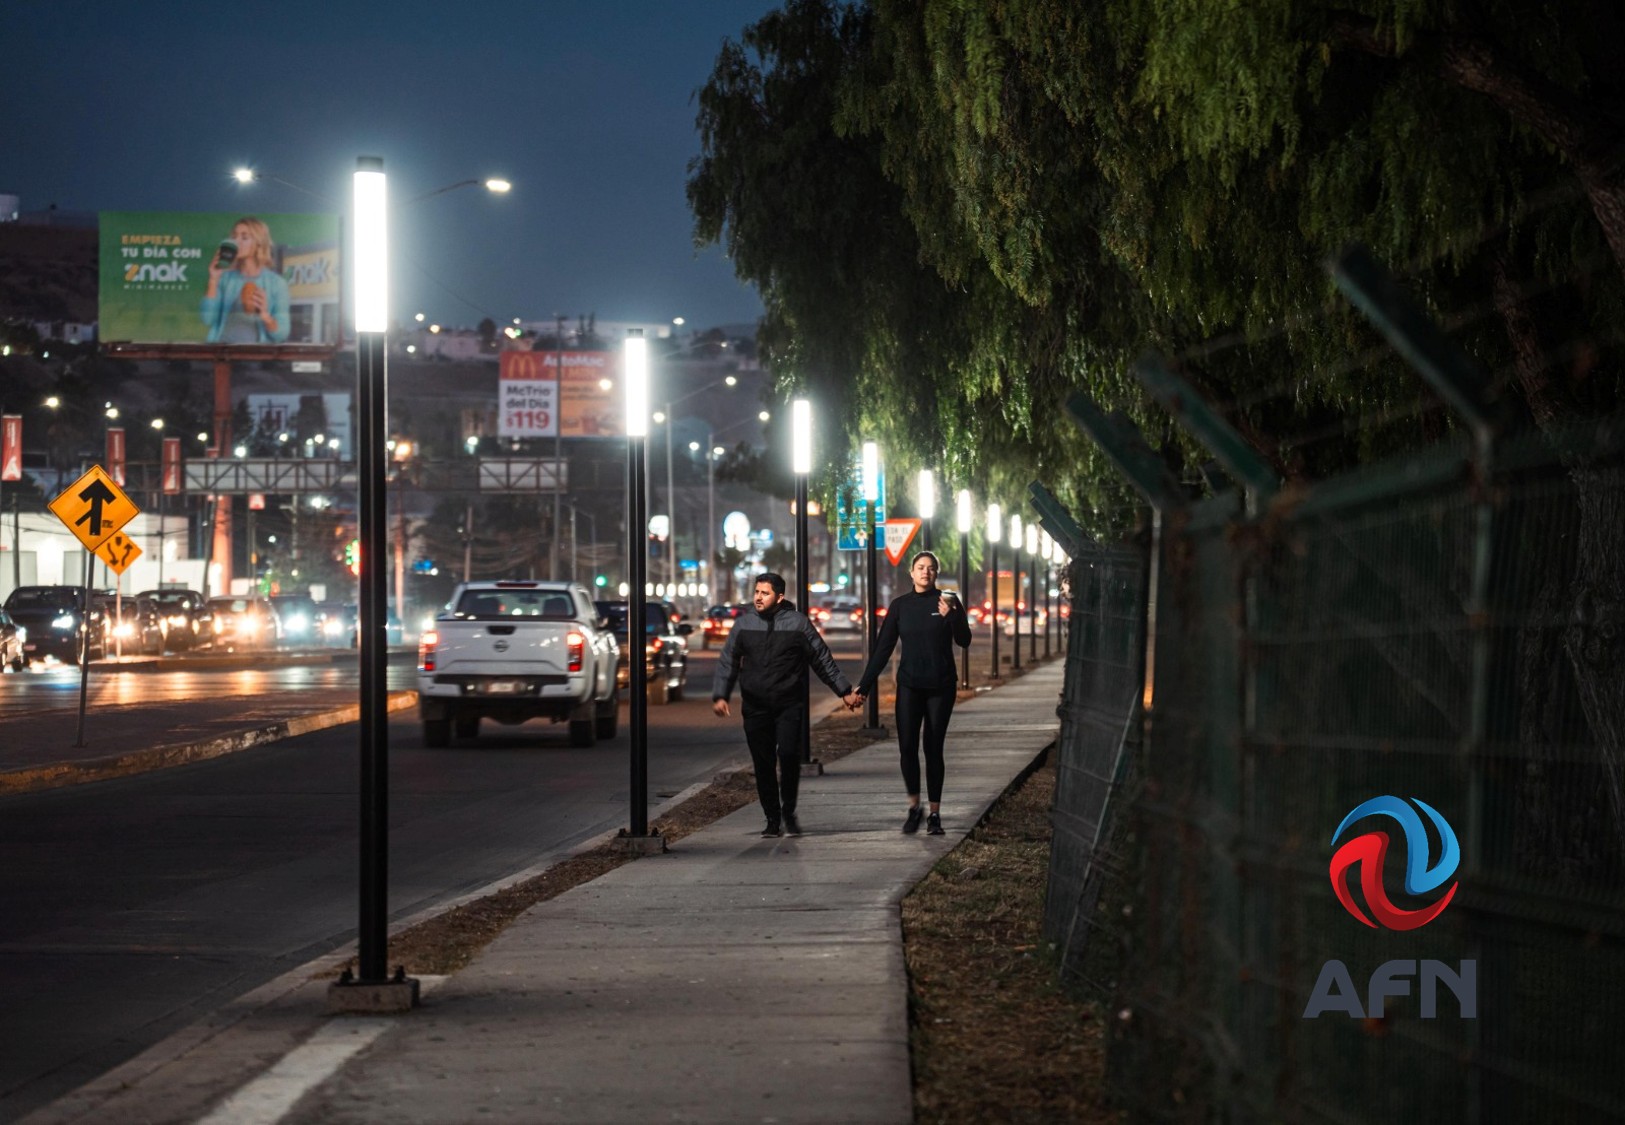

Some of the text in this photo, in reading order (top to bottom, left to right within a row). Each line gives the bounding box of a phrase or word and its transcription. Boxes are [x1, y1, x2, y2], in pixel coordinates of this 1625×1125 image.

[121, 235, 182, 246] EMPIEZA
[121, 245, 202, 258] TU DÍA CON
[506, 385, 551, 397] McTrio
[506, 398, 526, 409] del
[506, 411, 550, 429] $119
